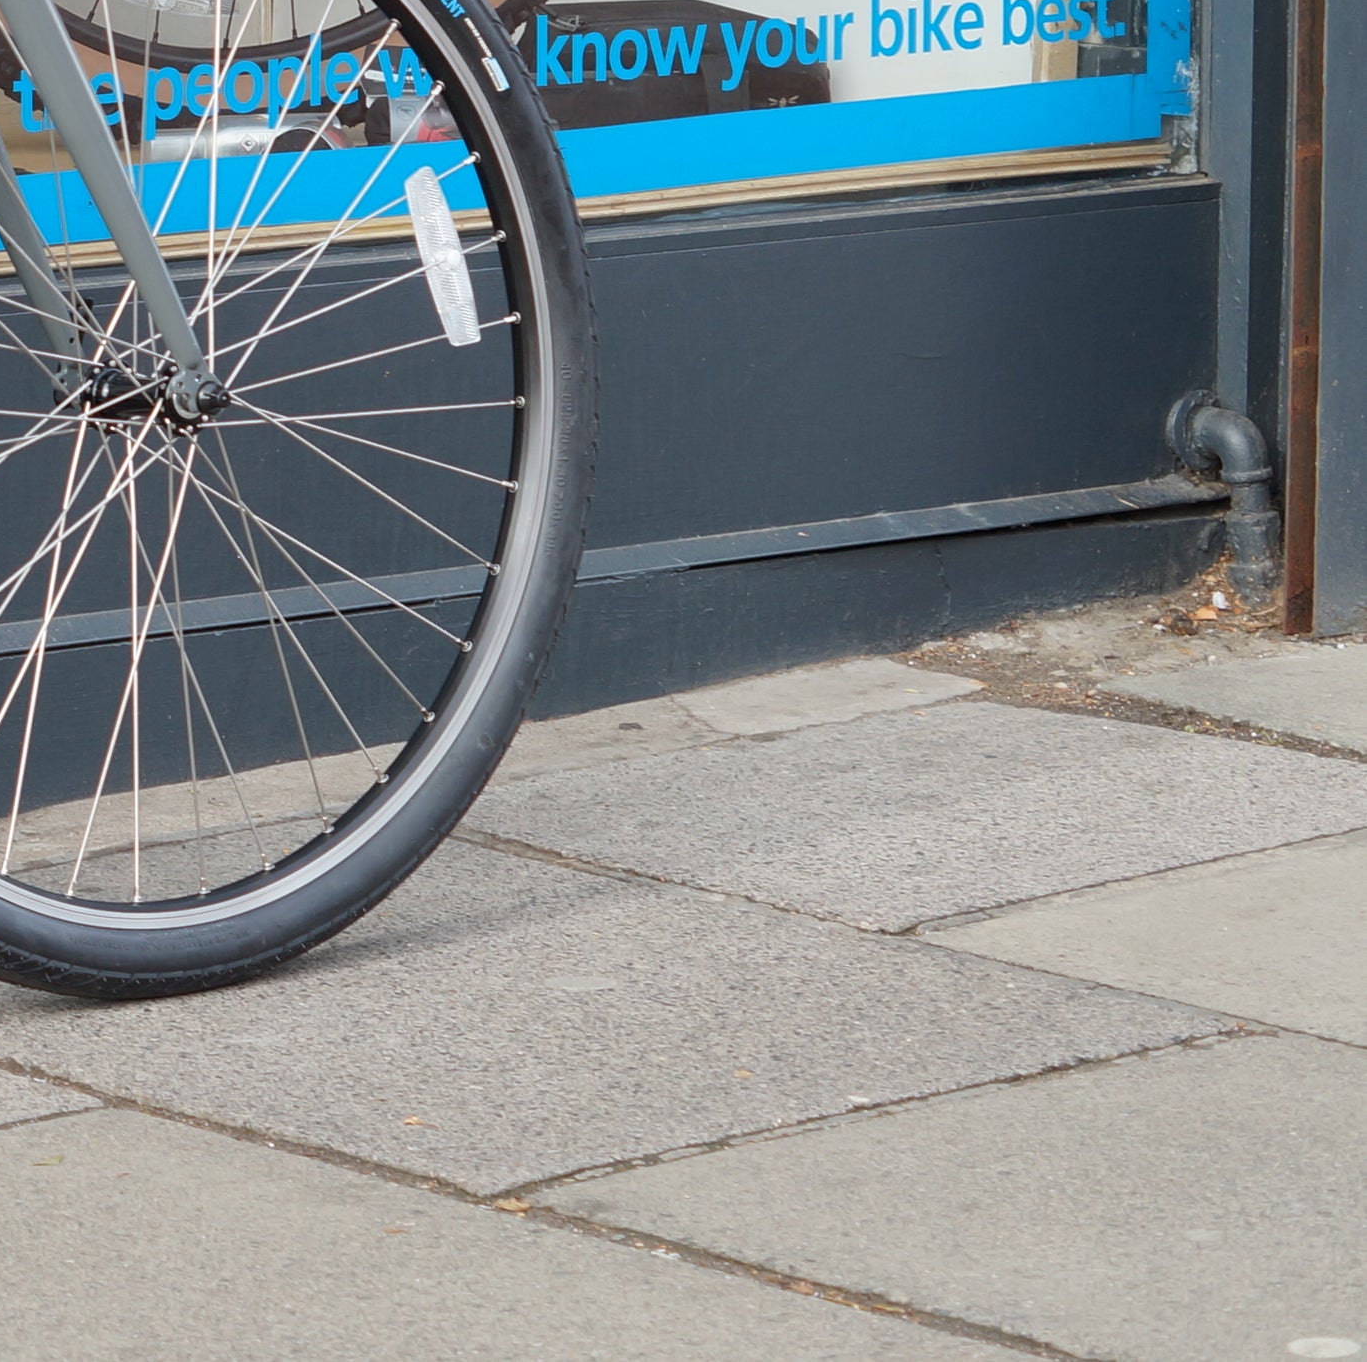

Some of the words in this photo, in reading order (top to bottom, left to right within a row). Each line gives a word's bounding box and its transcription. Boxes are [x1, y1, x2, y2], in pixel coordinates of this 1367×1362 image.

[20, 69, 123, 132] te
[144, 34, 361, 141] people
[536, 14, 707, 87] know
[721, 10, 854, 92] your
